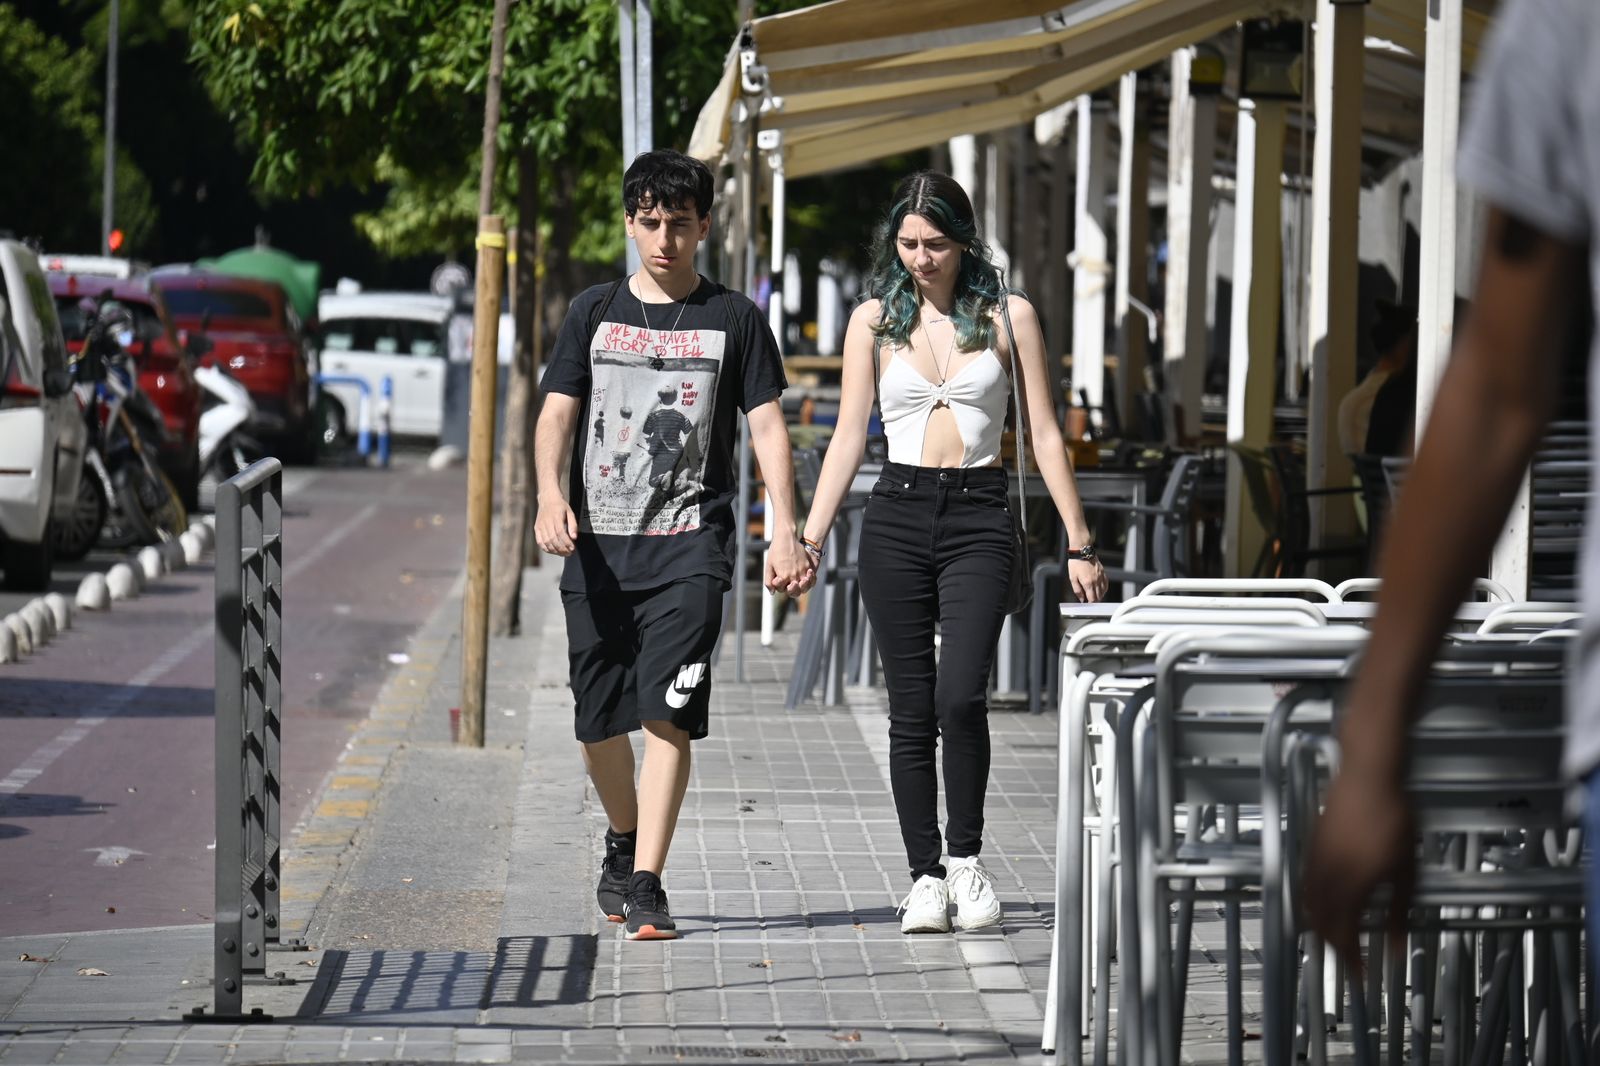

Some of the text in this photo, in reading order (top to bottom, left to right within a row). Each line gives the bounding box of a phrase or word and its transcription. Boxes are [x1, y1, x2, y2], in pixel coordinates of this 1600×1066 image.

[610, 323, 700, 344] WE ALL HAVE A
[603, 333, 704, 358] STORY TO TELL
